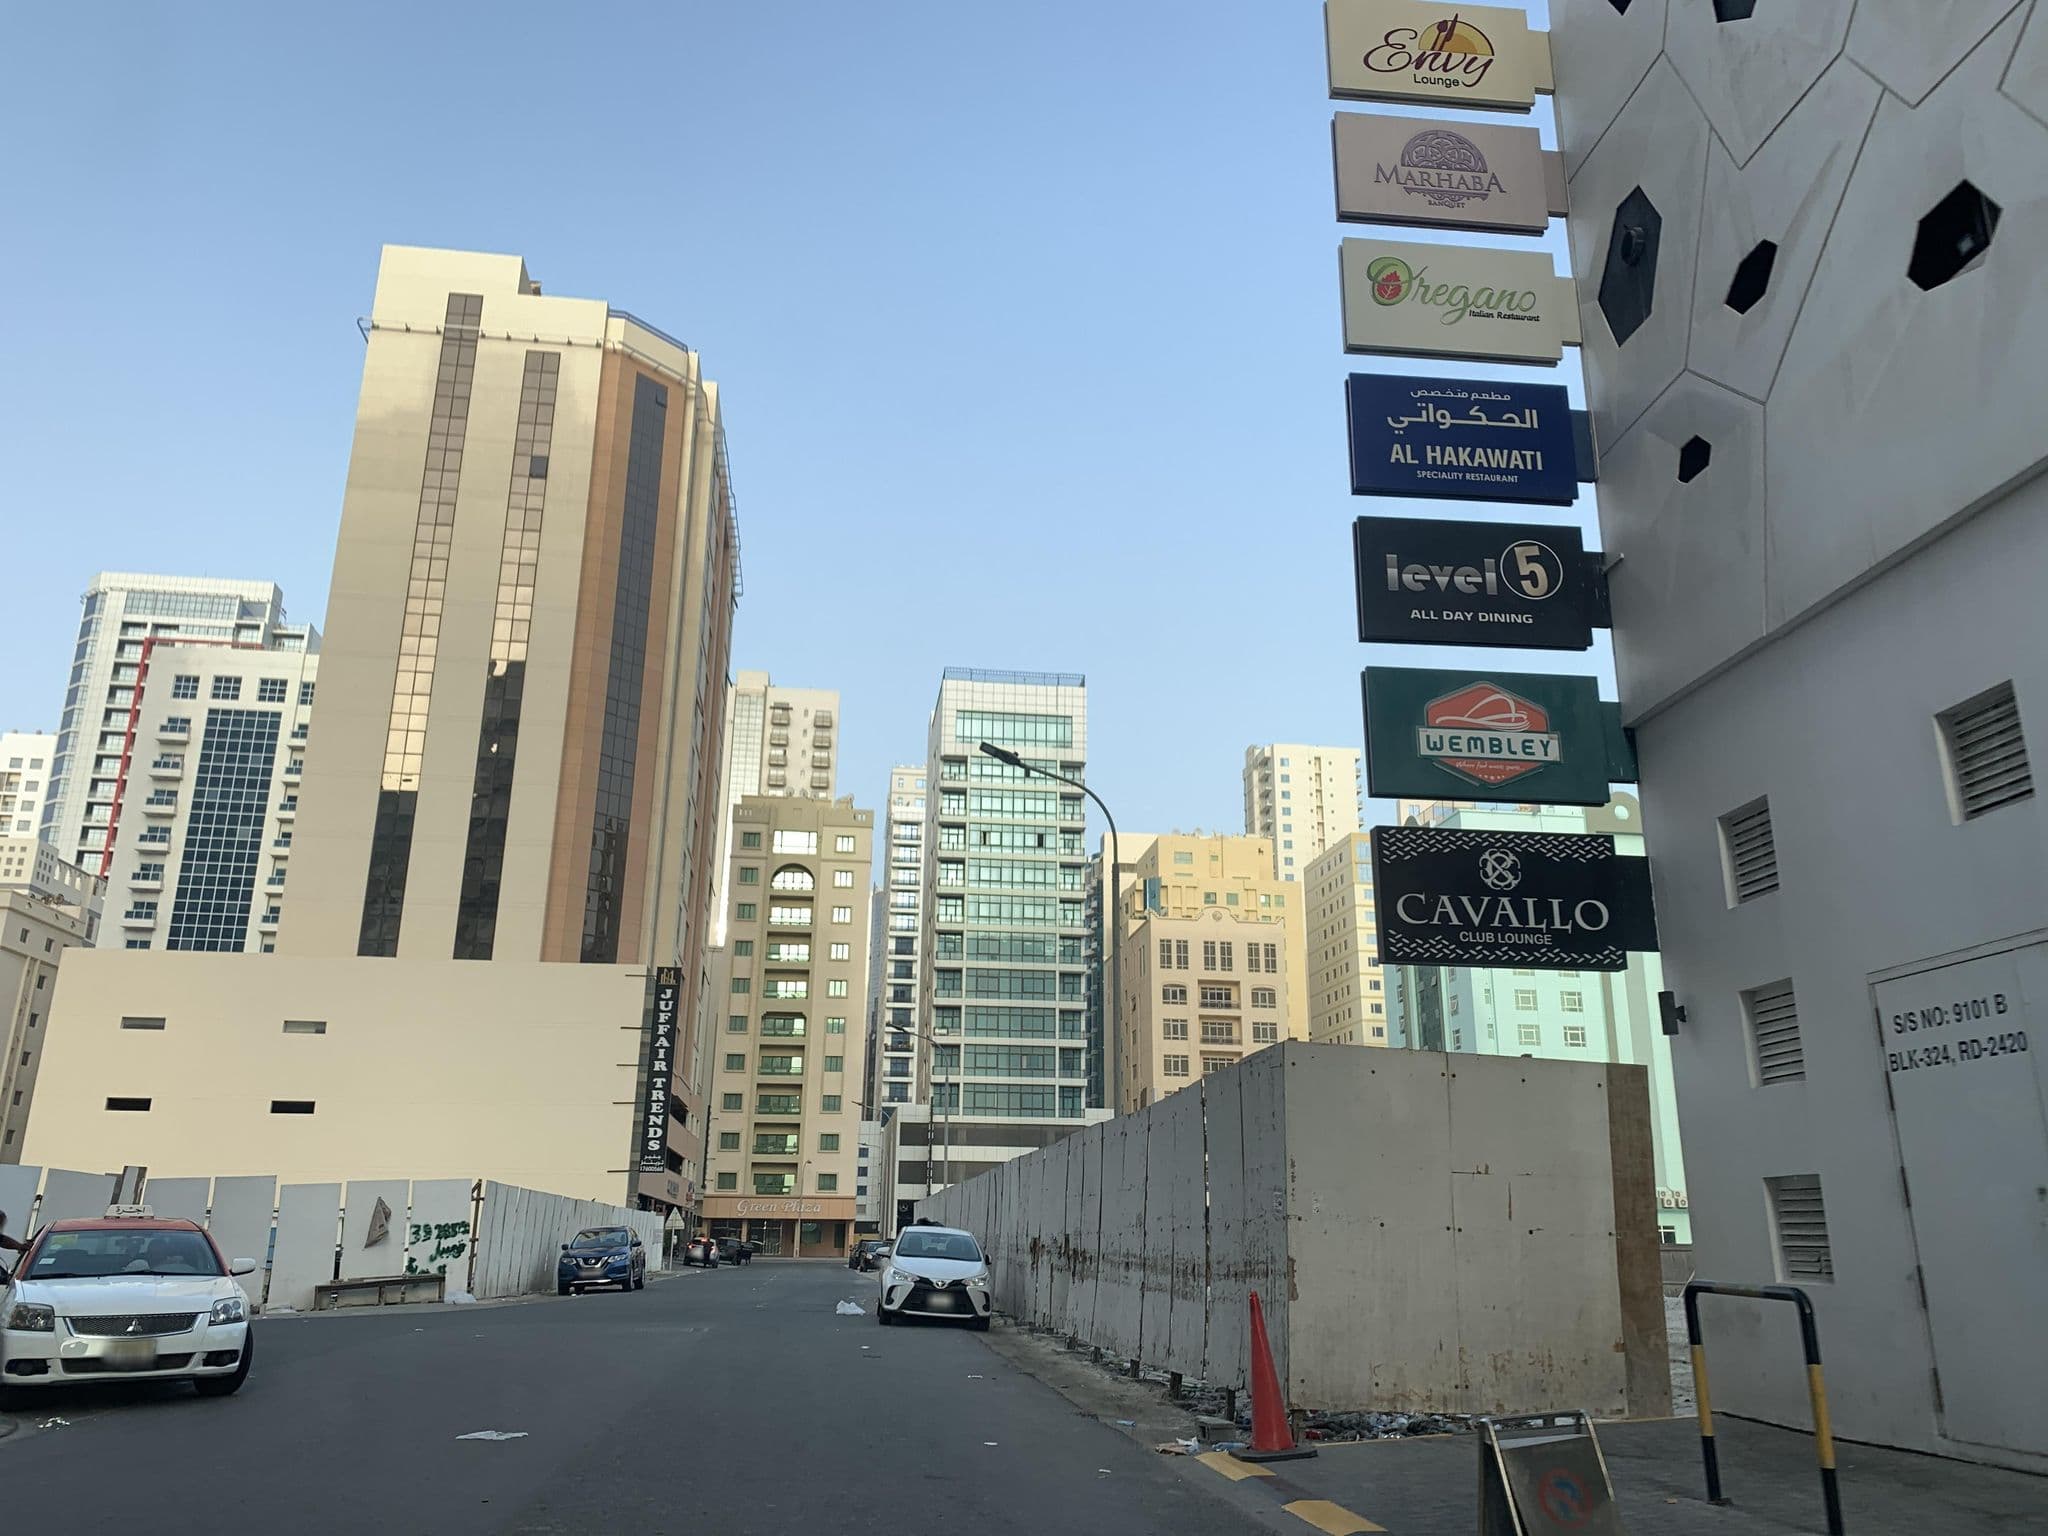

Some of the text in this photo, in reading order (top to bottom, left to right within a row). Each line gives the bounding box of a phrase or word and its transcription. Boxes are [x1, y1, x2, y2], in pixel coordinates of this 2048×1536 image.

[1363, 28, 1494, 87] Envy
[1413, 73, 1460, 88] Lounge
[1374, 162, 1507, 194] MARHABA
[1468, 309, 1540, 322] Italian Restaurant
[1410, 387, 1511, 401] مطعم متخصص
[1386, 402, 1539, 435] الحكواتي
[1390, 443, 1543, 471] AL HAKAWATI
[1416, 470, 1519, 483] SPECIALITY RESTAURANT
[1385, 545, 1549, 597] level 5
[1410, 609, 1534, 624] ALL DAY DINING
[1426, 734, 1551, 757] WEMBLEY
[1396, 893, 1609, 935] CAVALLO
[1459, 931, 1553, 945] CLUB LOUNGE
[1920, 1006, 1950, 1029] NO:
[1952, 997, 1990, 1023] 9101
[1993, 993, 2008, 1015] B
[1958, 1031, 2028, 1062] RD-2420
[647, 988, 673, 1151] JUFFAIR TRENDS
[736, 1199, 822, 1216] Green Plaza
